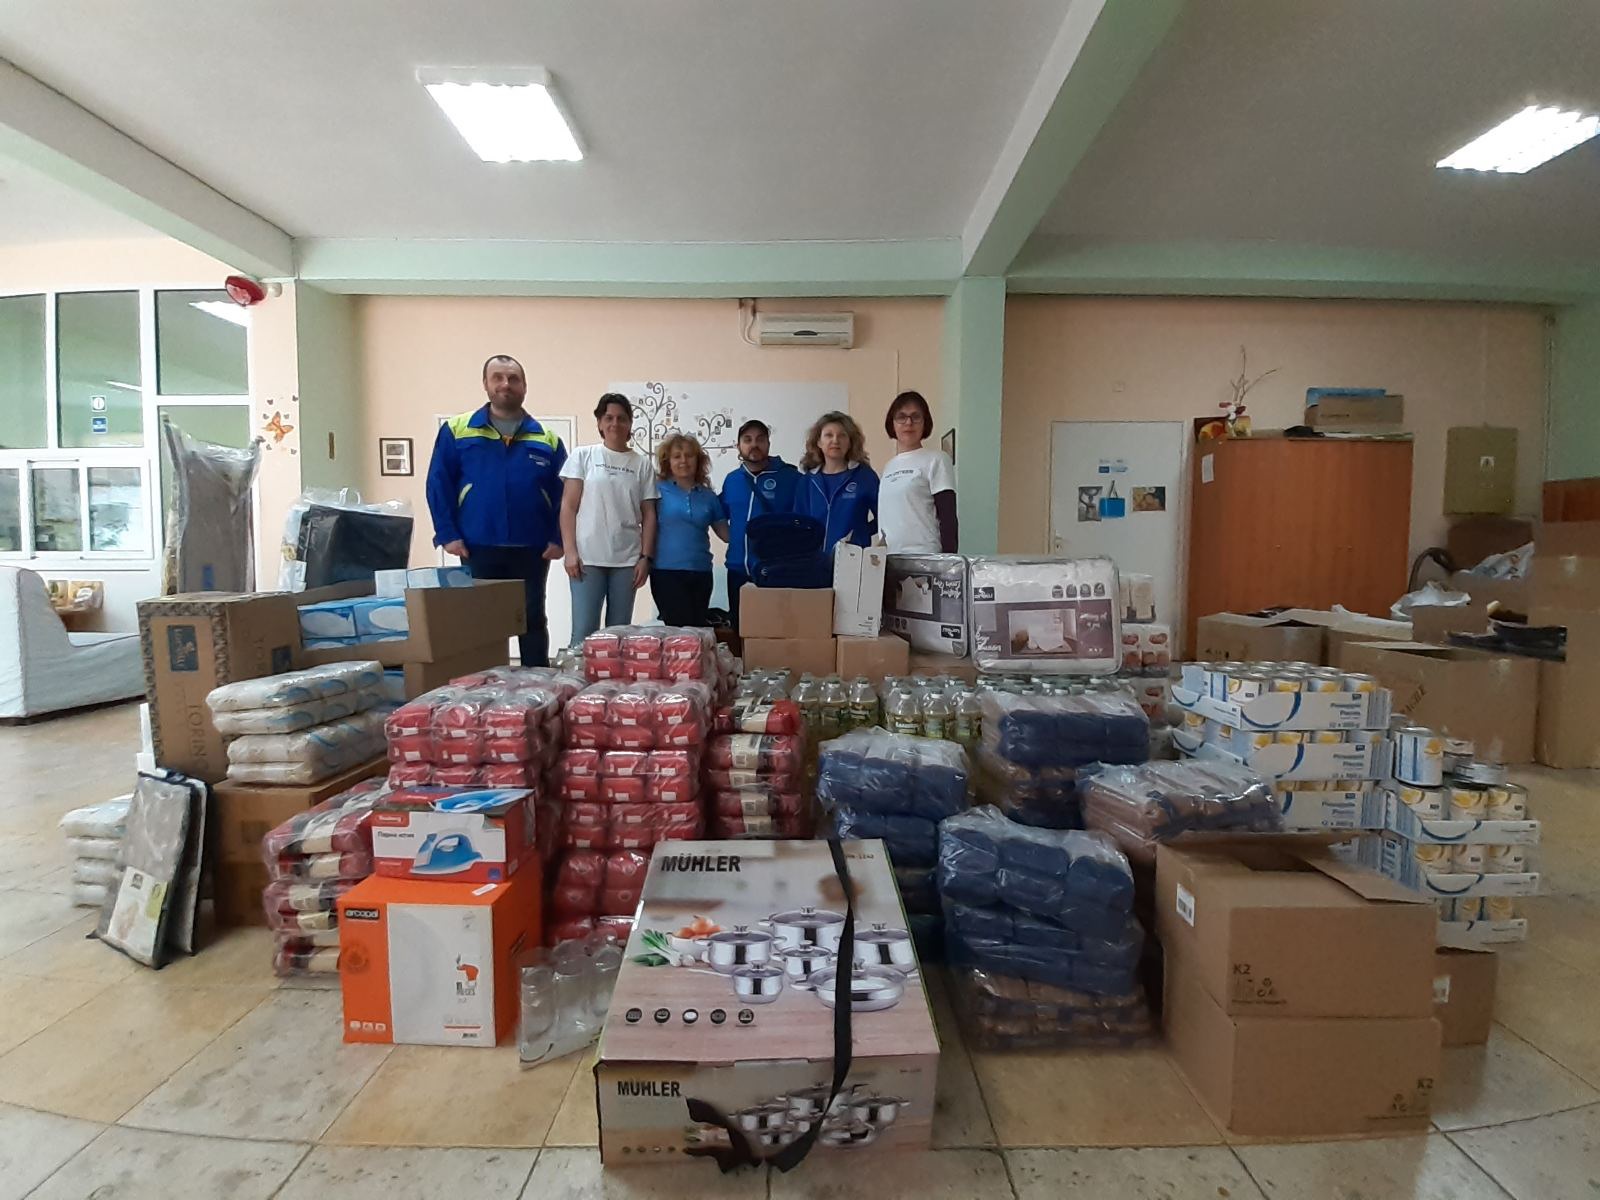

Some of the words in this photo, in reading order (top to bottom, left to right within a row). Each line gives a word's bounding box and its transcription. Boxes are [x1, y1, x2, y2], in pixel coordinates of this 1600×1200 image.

[661, 853, 741, 872] MÜHLER
[346, 909, 379, 918] arcopal
[1233, 964, 1251, 975] K2
[1417, 1078, 1434, 1089] K2
